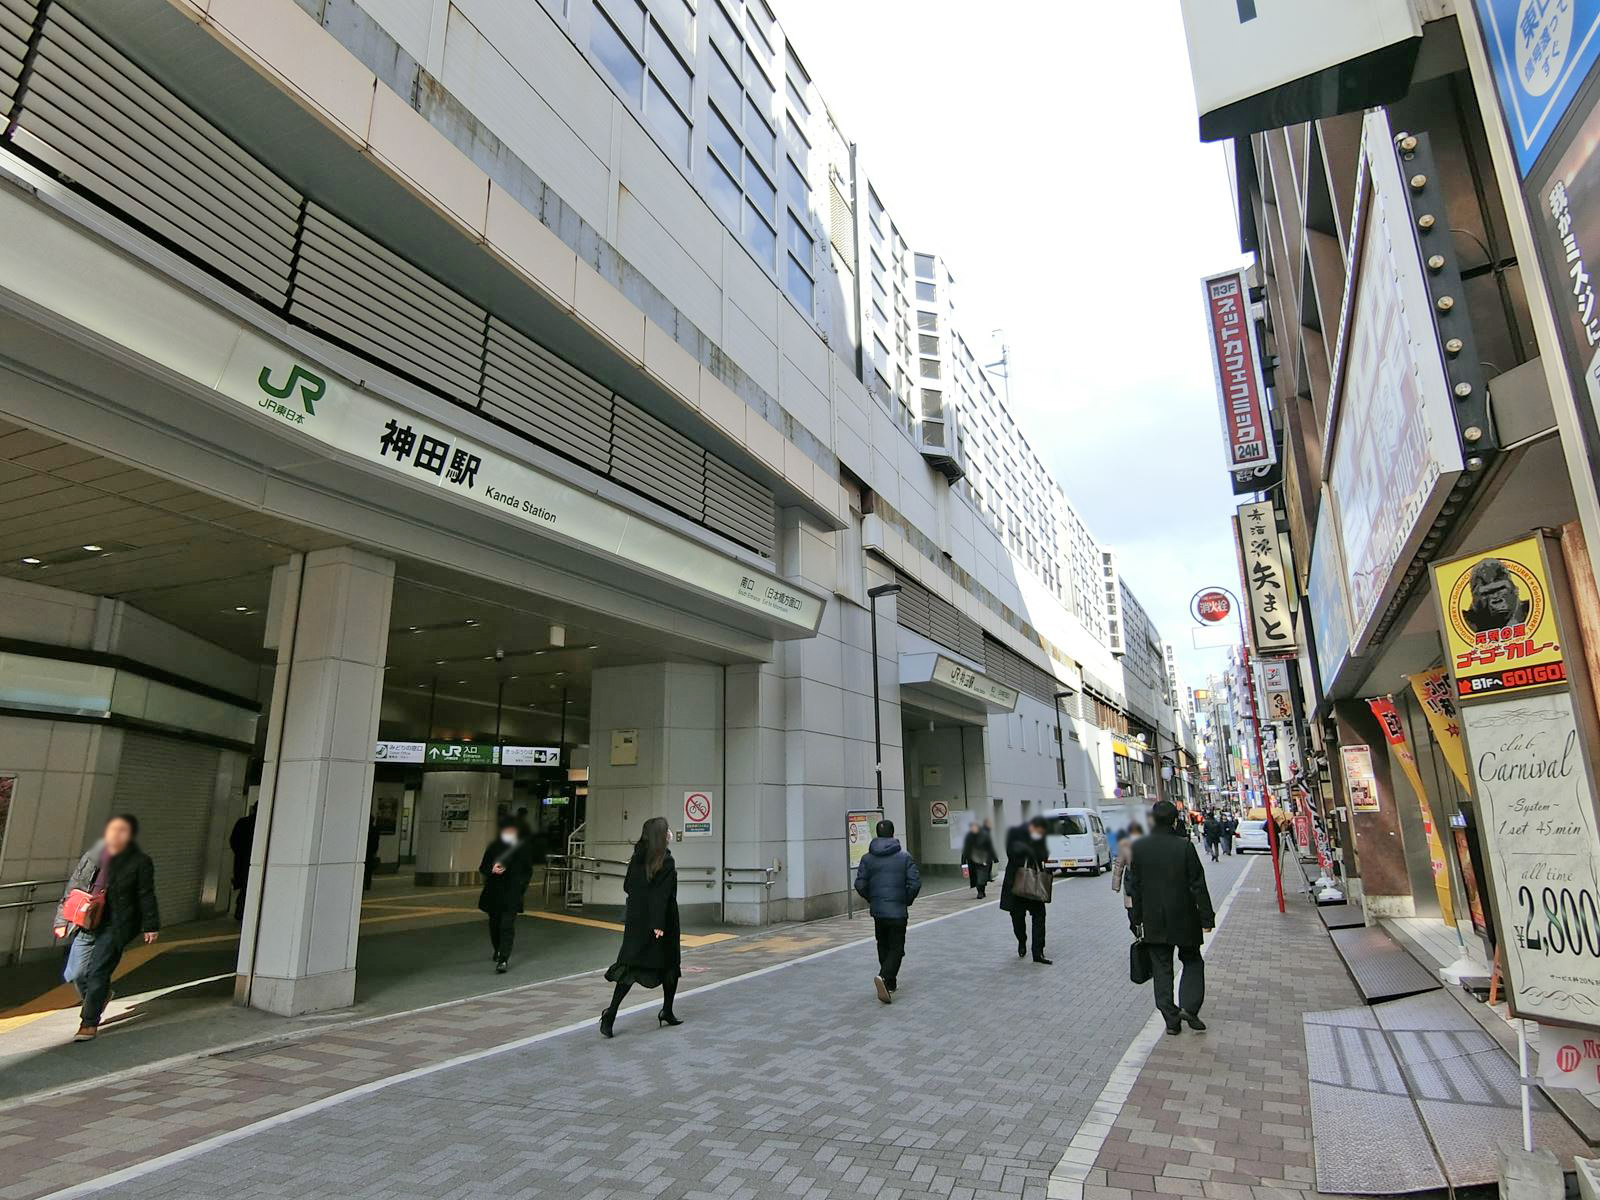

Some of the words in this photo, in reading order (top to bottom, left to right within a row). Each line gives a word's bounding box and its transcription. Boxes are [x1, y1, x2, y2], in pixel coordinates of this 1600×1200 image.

[258, 364, 326, 416] JR
[258, 398, 306, 425] JR東日本
[380, 418, 482, 489] 神田駅
[1237, 443, 1260, 459] 24H
[485, 485, 519, 508] Kanda
[521, 500, 557, 523] Station
[739, 576, 755, 591] 南口
[1199, 599, 1229, 614] 消火栓
[1252, 560, 1287, 640] 矢まと
[1456, 639, 1554, 669] ゴーゴーカレー
[441, 745, 462, 757] JR
[463, 746, 478, 754] 入口
[1479, 729, 1576, 782] Carnival
